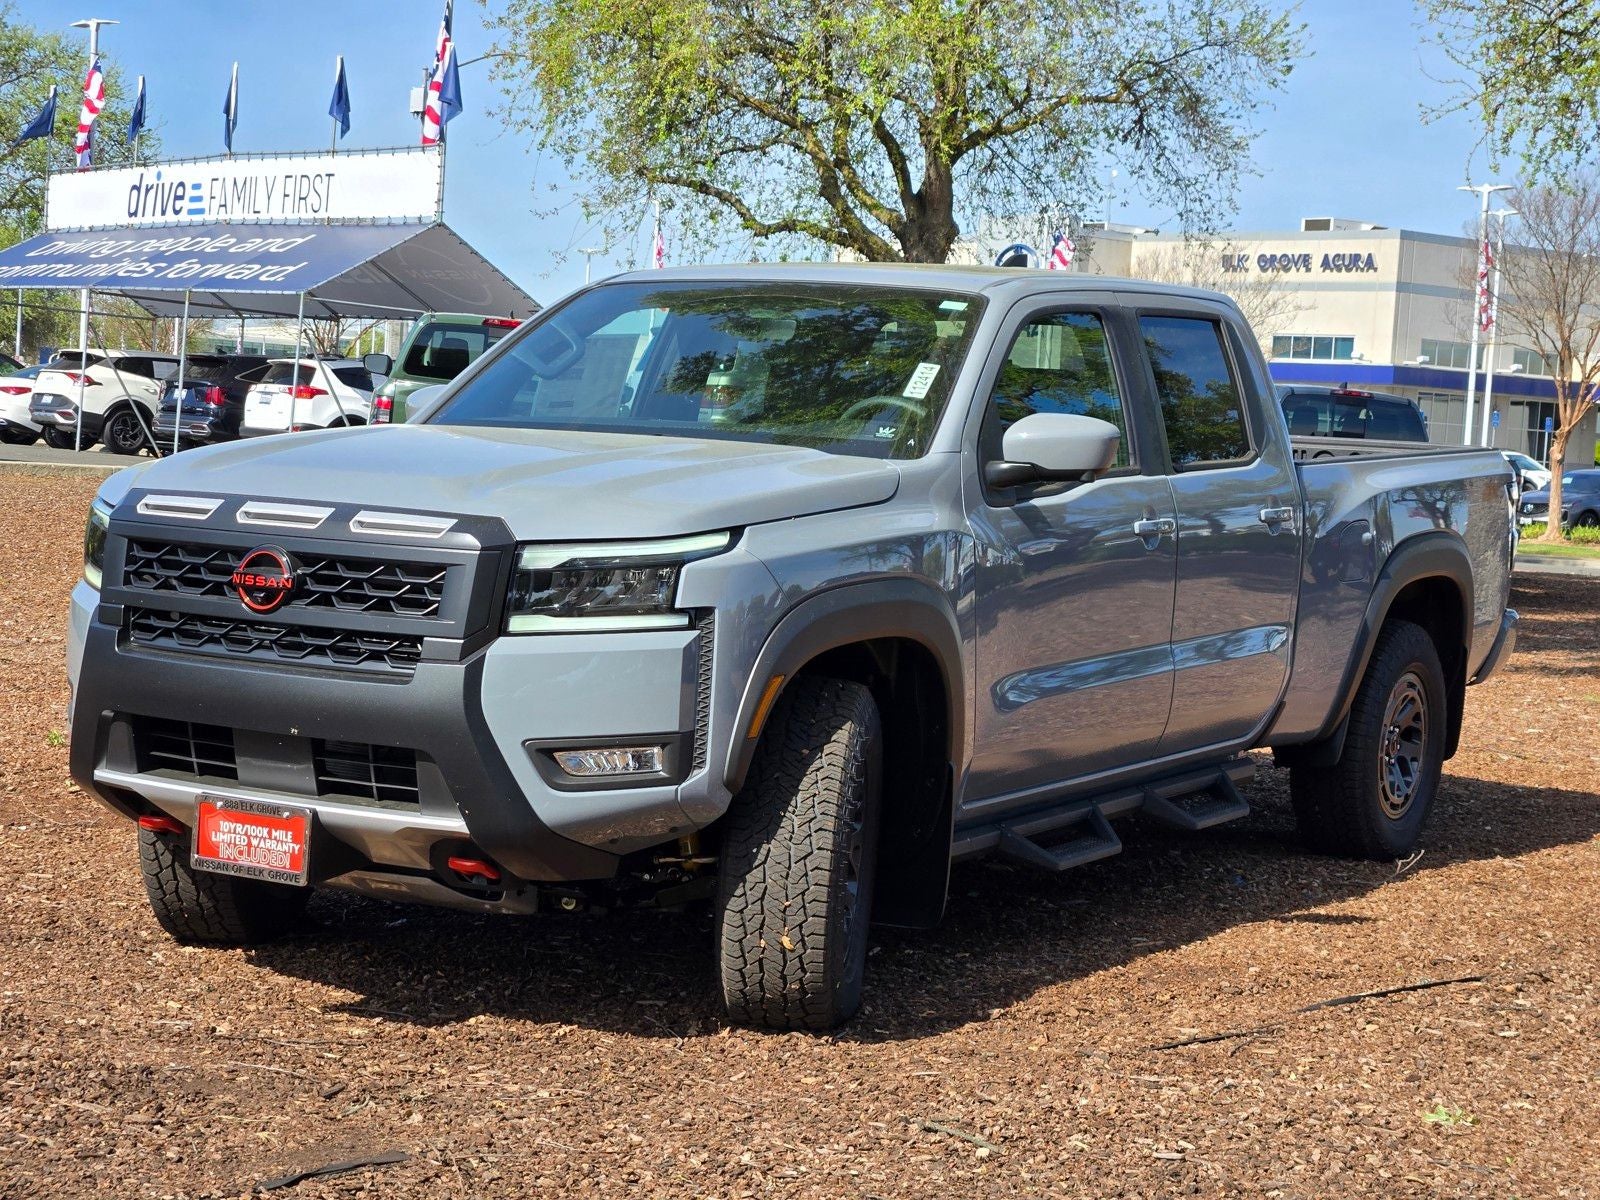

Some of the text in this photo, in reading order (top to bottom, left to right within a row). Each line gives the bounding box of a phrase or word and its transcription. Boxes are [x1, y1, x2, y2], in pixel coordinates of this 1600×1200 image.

[127, 170, 335, 218] drive FAMILY FIRST
[25, 234, 317, 259] Driving people and
[0, 256, 168, 278] ommunities
[154, 258, 309, 281] forward.
[1257, 253, 1311, 271] GROVE
[1320, 252, 1376, 271] ACURA
[232, 572, 293, 589] NISSAN
[240, 801, 255, 812] ELK
[257, 803, 281, 816] GROVE
[211, 830, 301, 855] LIMITED WARRANTY
[219, 820, 293, 843] 10YR/100K MILE
[218, 842, 291, 869] INCLUDED!
[195, 858, 301, 883] NISSAN OF ELK GROVE
